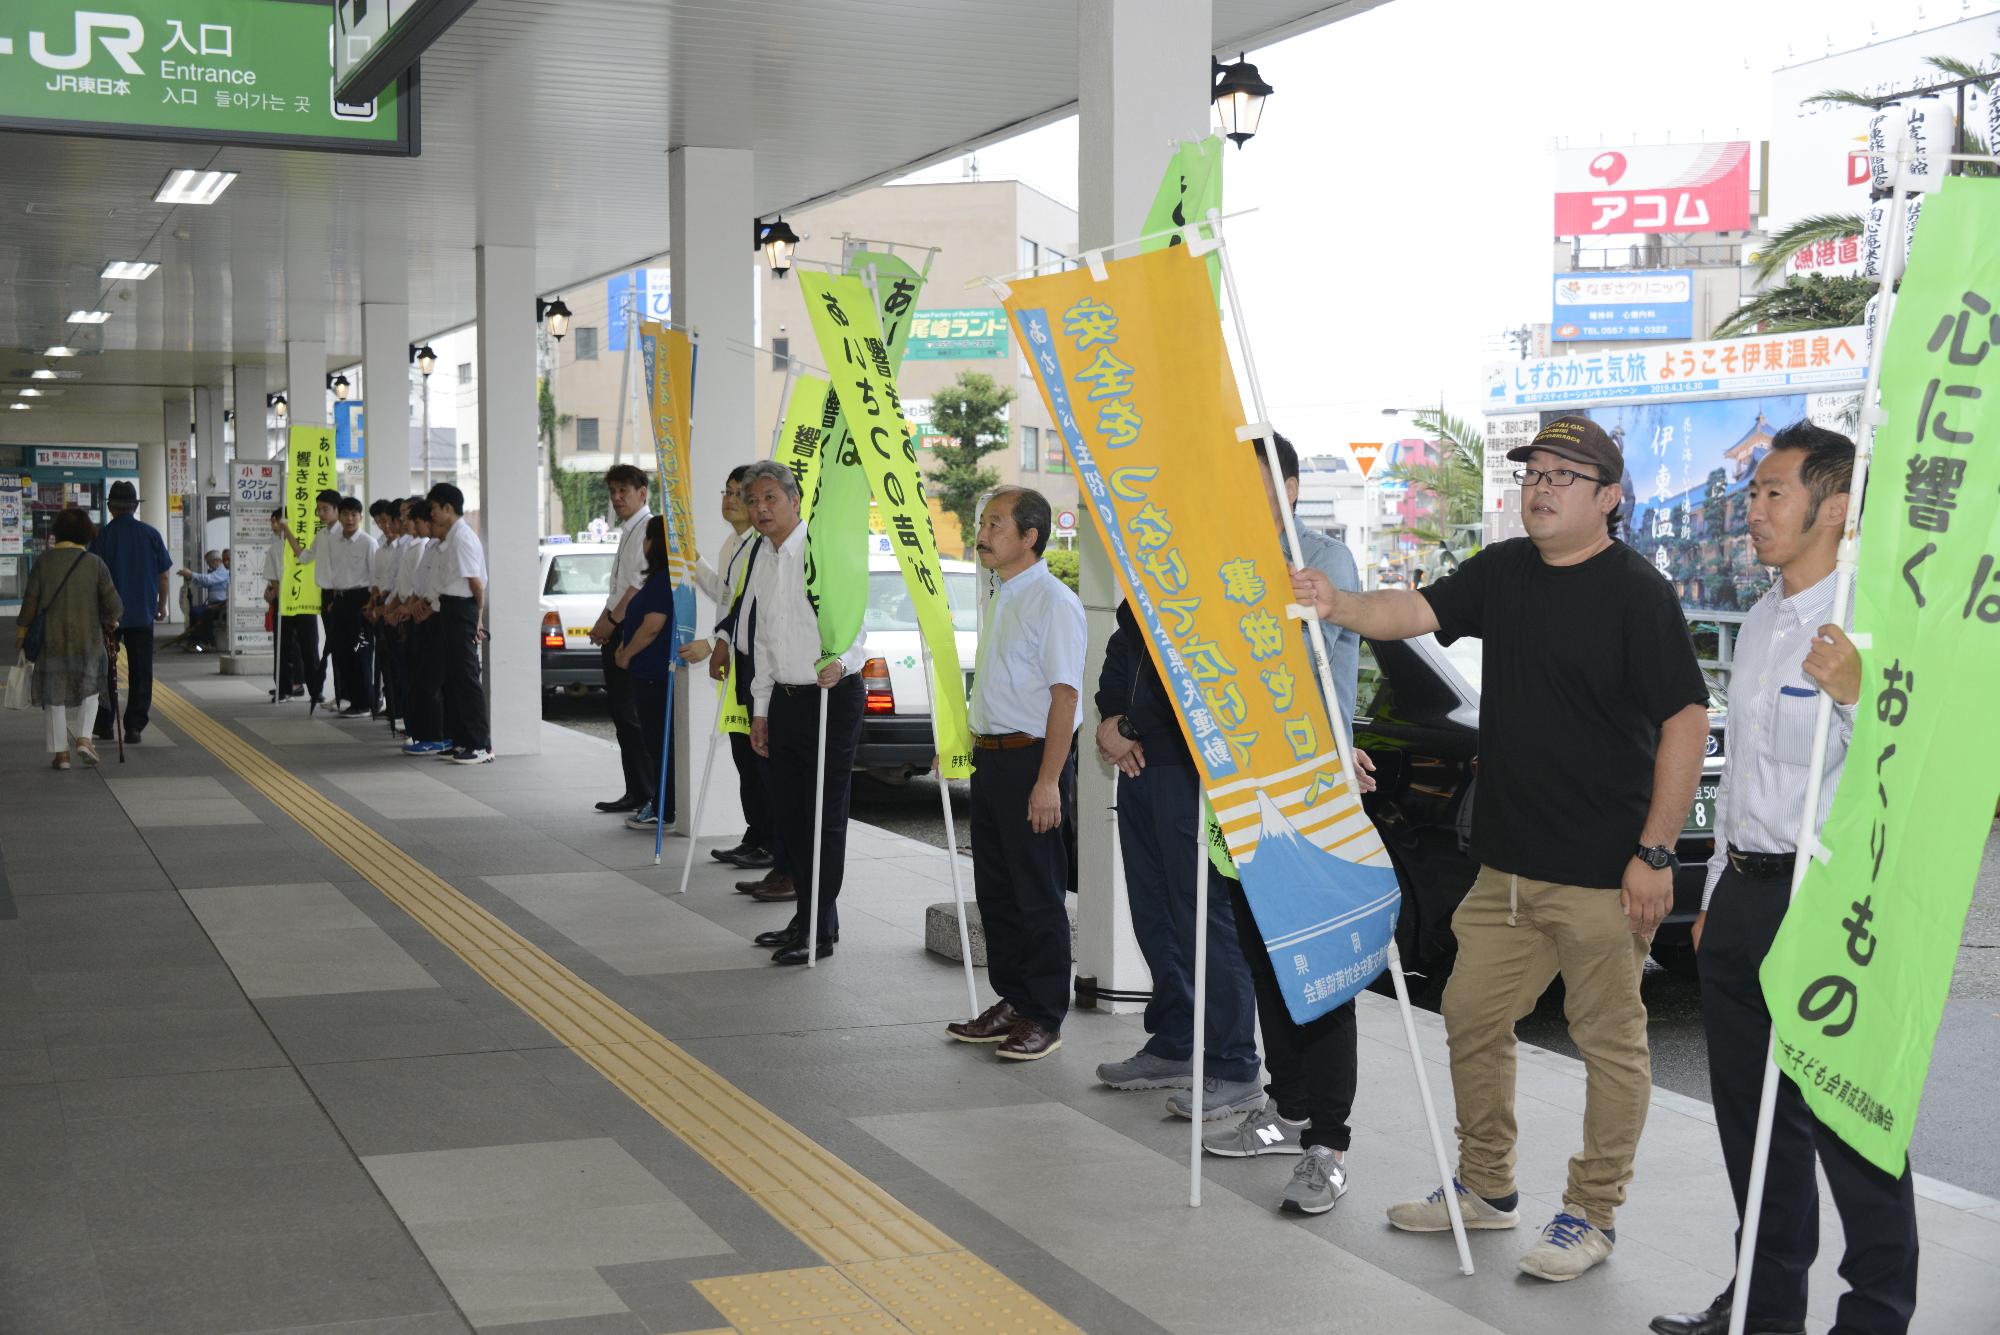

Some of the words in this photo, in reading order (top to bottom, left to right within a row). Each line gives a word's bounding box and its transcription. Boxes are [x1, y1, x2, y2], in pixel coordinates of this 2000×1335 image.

[29, 11, 145, 75] JR
[161, 19, 232, 58] 入口
[46, 74, 131, 96] JR東日本
[161, 60, 257, 86] Entrance
[162, 87, 197, 104] 入口
[214, 90, 286, 112] 들어가는
[293, 96, 311, 113] 곳
[1591, 194, 1710, 231] アコム
[1587, 280, 1687, 296] なぎさクリニック
[908, 318, 1007, 339] 尾崎ランド
[1515, 353, 1648, 391] しずおか元気旅
[1659, 335, 1856, 380] ようこそ伊東温泉へ
[1901, 290, 2000, 609] 心に響く
[237, 479, 278, 489] タクシー
[241, 490, 273, 500] のりば
[1651, 424, 1675, 581] 伊東温泉
[1797, 658, 1914, 1038] おくりもの
